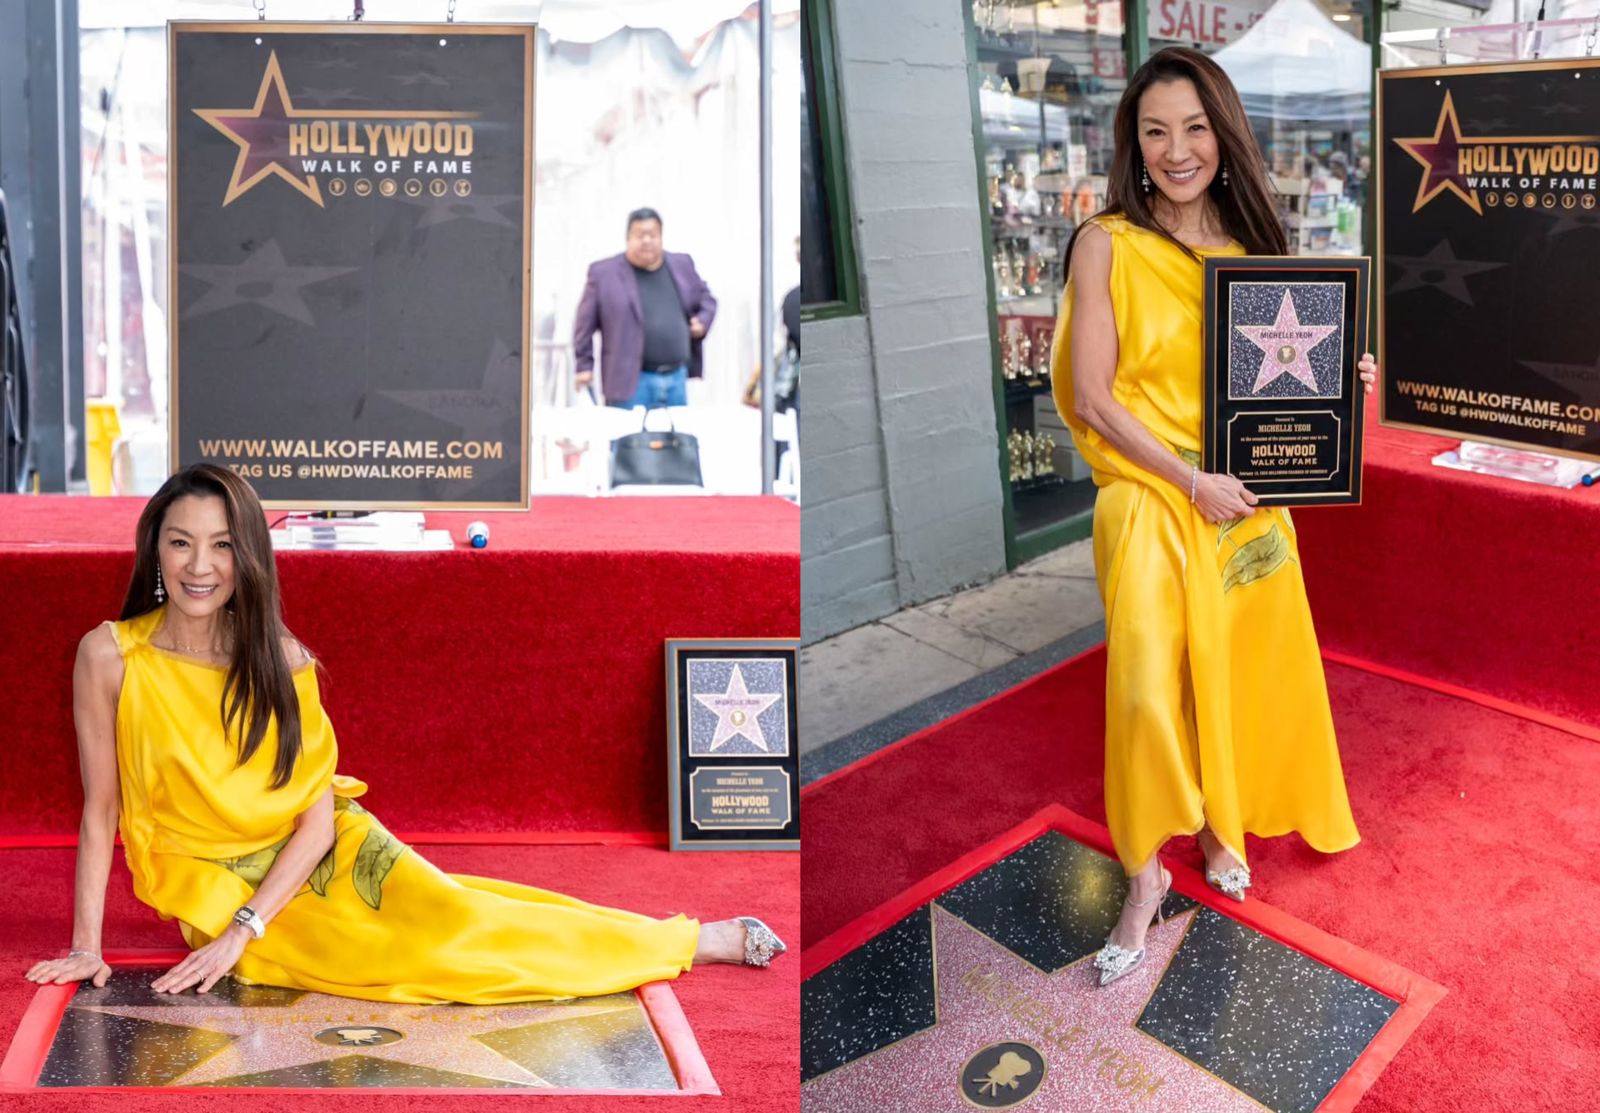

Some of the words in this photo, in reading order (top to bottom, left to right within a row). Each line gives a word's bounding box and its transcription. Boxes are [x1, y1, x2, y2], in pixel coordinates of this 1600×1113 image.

[1159, 0, 1226, 44] SALE
[289, 120, 474, 157] HOLLYWOOD
[302, 160, 361, 174] WALK
[374, 160, 400, 174] OF
[414, 161, 473, 174] FAME
[1458, 145, 1599, 175] HOLLYWOOD
[1467, 178, 1511, 188] WALK
[1519, 178, 1541, 189] OF
[1550, 179, 1597, 190] FAME
[1260, 331, 1294, 339] MICHELLE
[1416, 400, 1437, 412] TAG
[1441, 404, 1457, 416] US
[1460, 408, 1587, 436] @HWDWALKOFFAME
[1258, 423, 1293, 433] MICHELLE
[1294, 423, 1312, 432] YEOH
[199, 439, 503, 460] WWW.WALKOFFAME.COM
[1252, 444, 1316, 458] HOLLYWOOD
[1251, 458, 1275, 466] WALK
[1278, 458, 1290, 466] OF
[1292, 457, 1318, 466] FAME
[229, 464, 263, 478] TAG
[268, 464, 293, 478] US
[297, 464, 473, 479] @HWDWALKOFFAME
[712, 795, 770, 807] HOLLYWOOD
[711, 807, 733, 815] WALK
[748, 807, 771, 815] FAME
[961, 964, 1087, 1050] MICHELLE
[1084, 1039, 1166, 1102] YEOH
